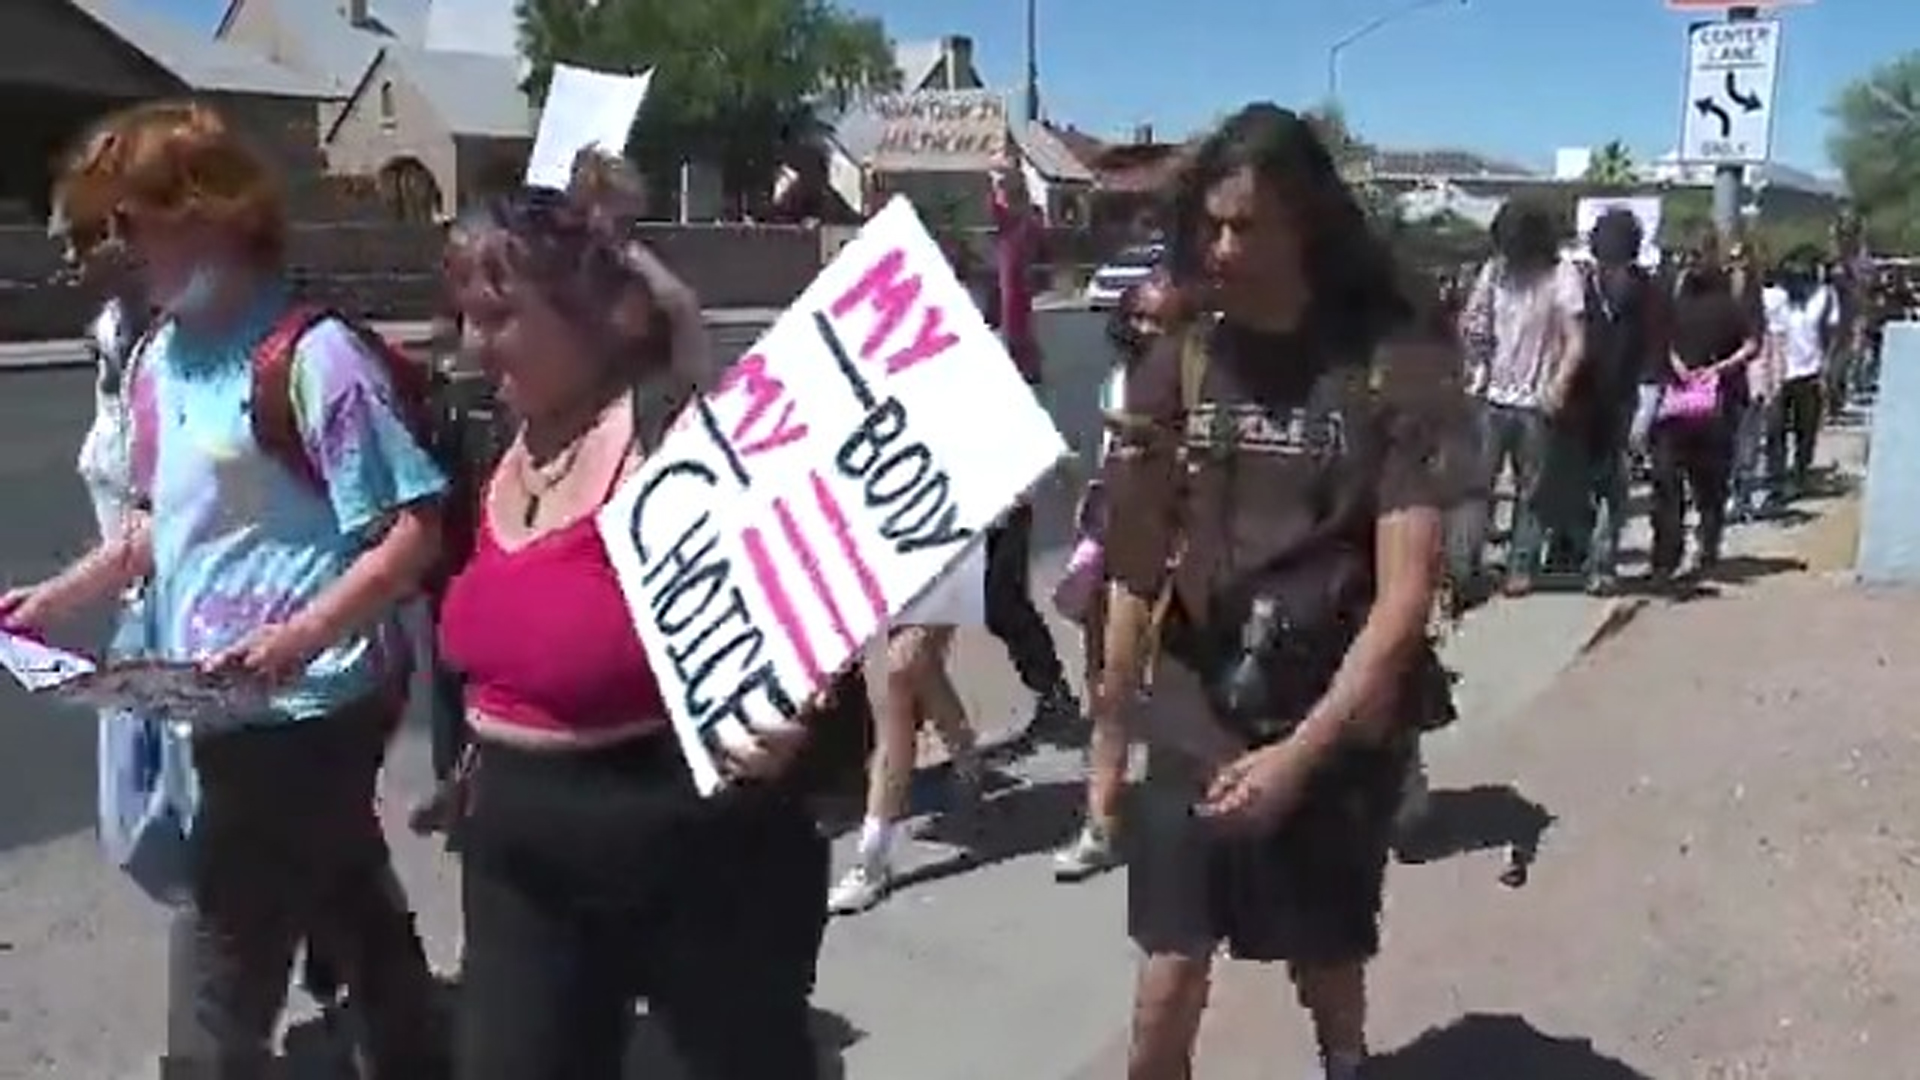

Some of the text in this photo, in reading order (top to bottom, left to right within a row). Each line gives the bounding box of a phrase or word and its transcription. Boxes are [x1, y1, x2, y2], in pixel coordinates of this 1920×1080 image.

[1700, 28, 1770, 45] CENTER
[1708, 47, 1757, 60] LANE
[828, 248, 960, 374] MY
[707, 354, 808, 456] MY
[835, 396, 974, 554] BODY
[630, 460, 797, 752] CHOICE
